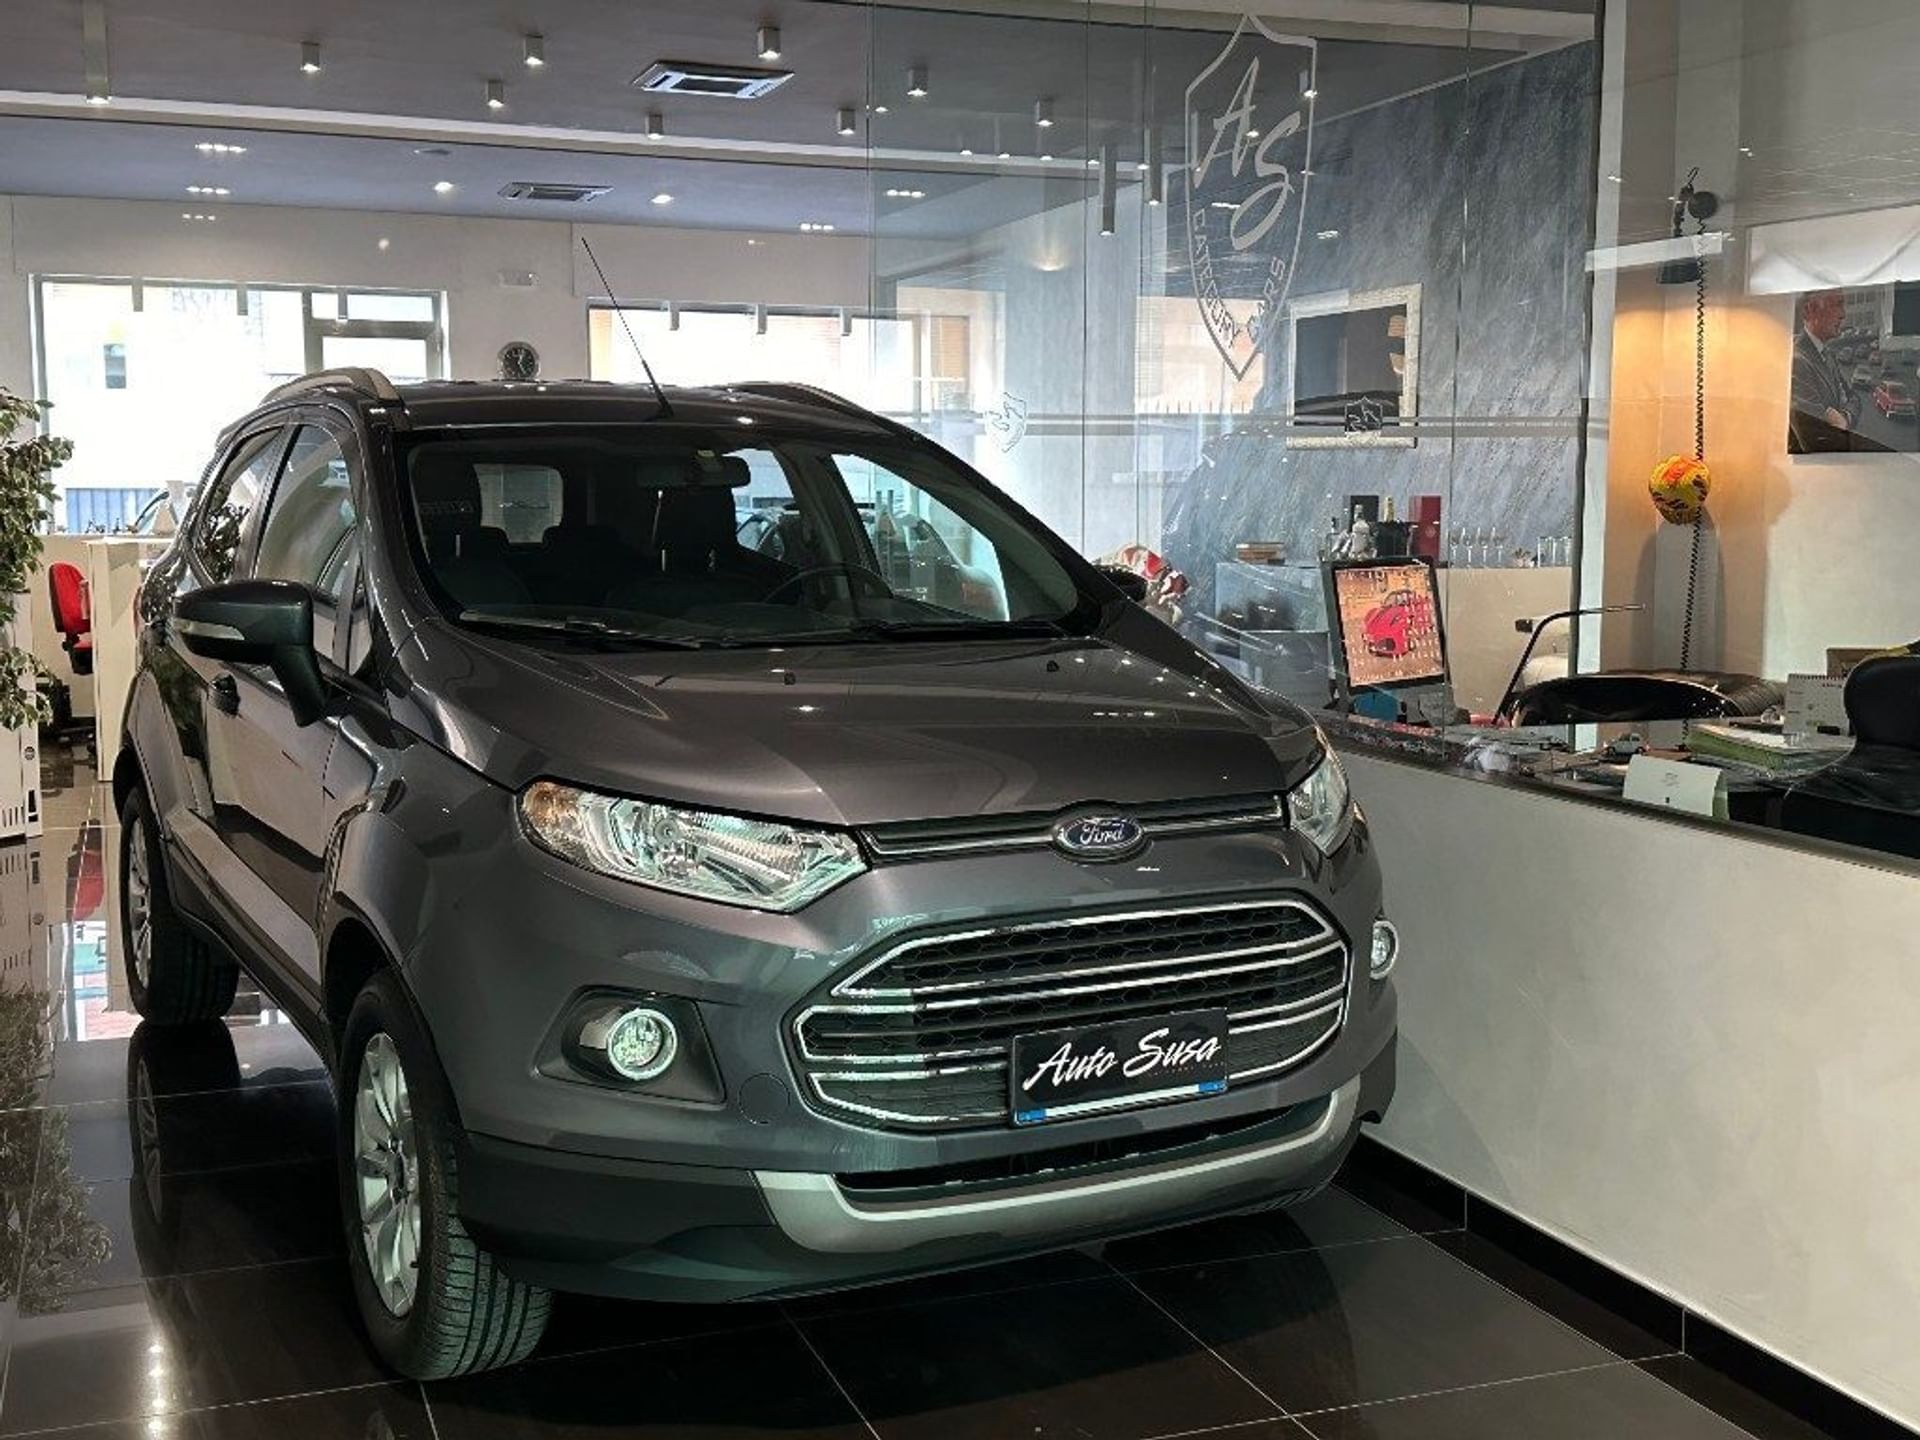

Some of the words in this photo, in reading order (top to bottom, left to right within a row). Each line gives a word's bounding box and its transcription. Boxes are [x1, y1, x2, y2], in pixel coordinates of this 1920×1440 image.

[1079, 823, 1125, 845] Ford
[1022, 1042, 1119, 1091] Auto
[1123, 1027, 1222, 1078] Susa
